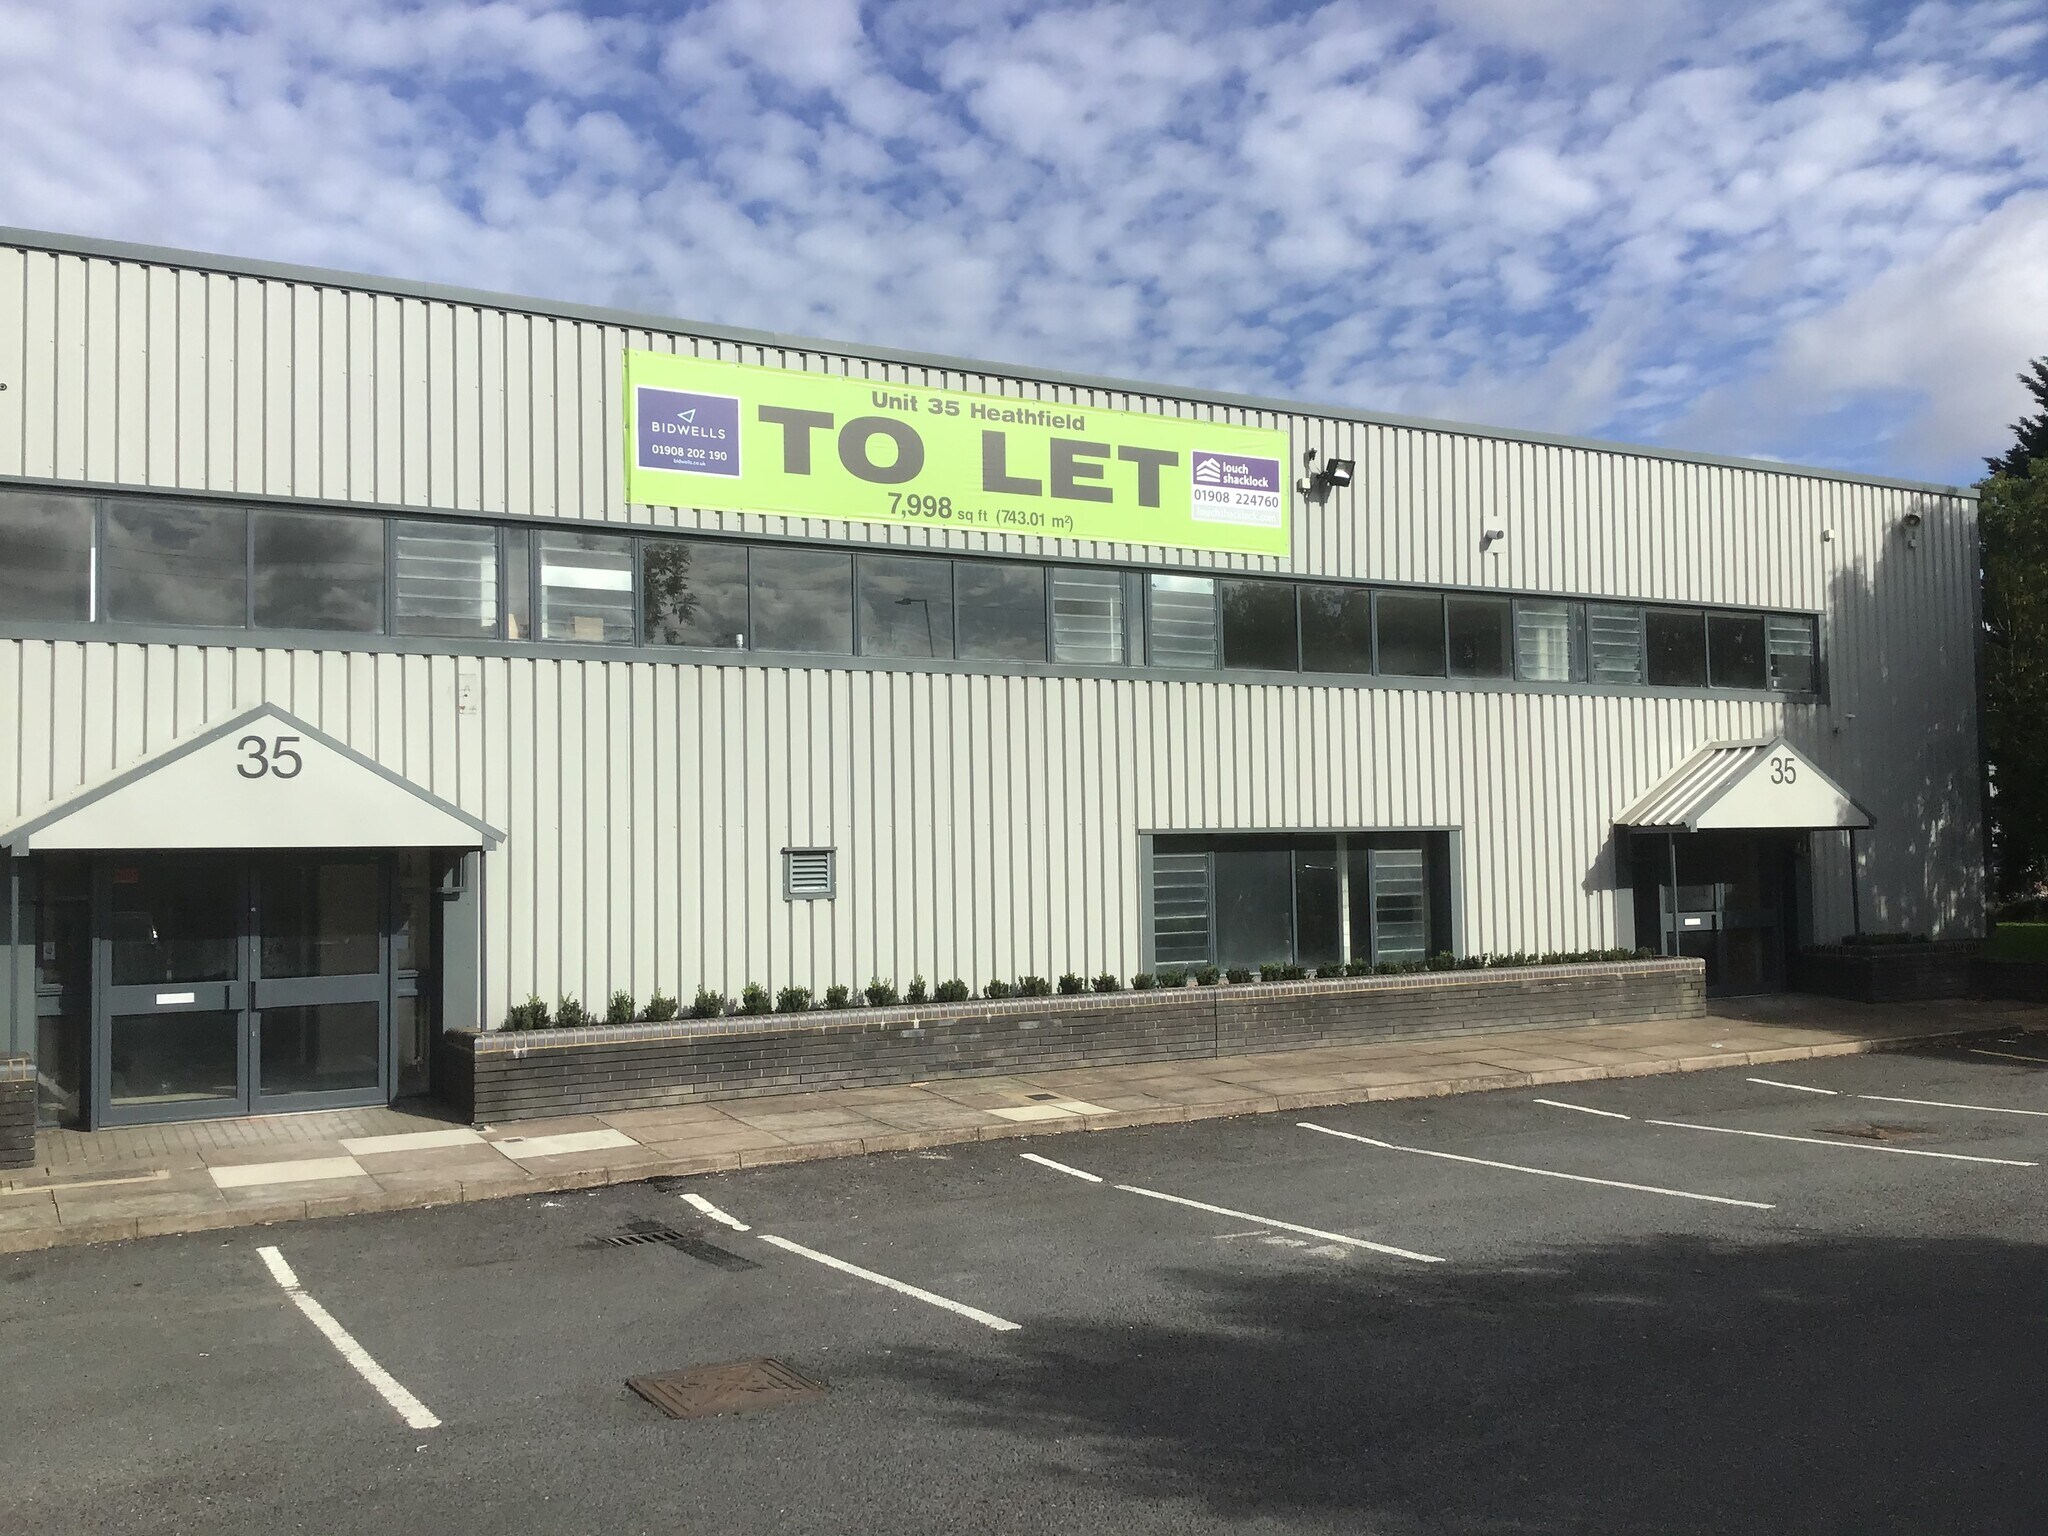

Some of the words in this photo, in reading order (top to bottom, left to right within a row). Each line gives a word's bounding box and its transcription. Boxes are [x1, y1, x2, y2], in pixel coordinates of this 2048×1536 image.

[872, 391, 918, 412] Unit
[928, 398, 960, 416] 35
[970, 403, 1085, 431] Heathfield
[651, 421, 726, 440] BIDWELLS
[651, 444, 684, 457] 01908
[687, 448, 706, 459] 202
[708, 450, 727, 461] 190
[758, 404, 925, 484] TO
[982, 430, 1179, 508] LET
[673, 458, 706, 467] bidwells.co.uk
[1223, 461, 1249, 475] louch
[1223, 473, 1269, 488] shacklock
[1194, 489, 1230, 503] 01908
[1235, 493, 1279, 508] 224760
[887, 492, 952, 519] 7,998
[957, 510, 974, 523] sq
[978, 509, 988, 522] ft
[996, 509, 1045, 527] (743.01
[237, 735, 302, 779] 35
[1770, 757, 1797, 785] 35
